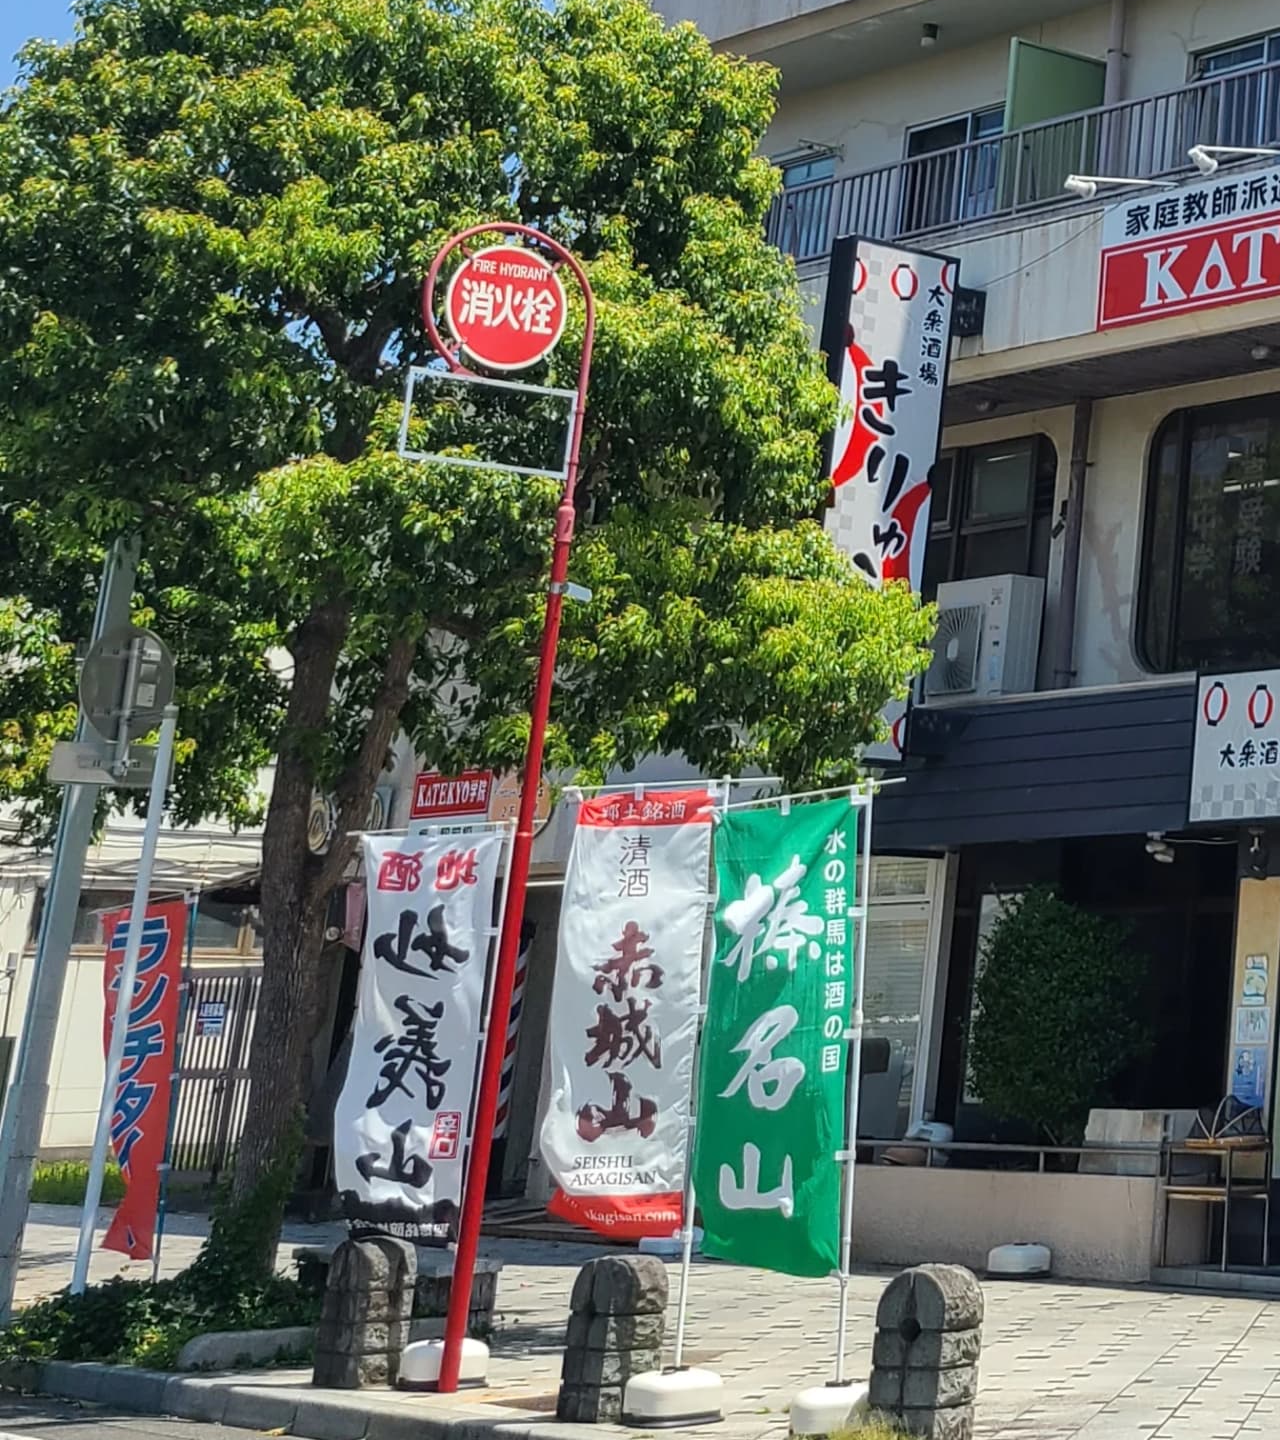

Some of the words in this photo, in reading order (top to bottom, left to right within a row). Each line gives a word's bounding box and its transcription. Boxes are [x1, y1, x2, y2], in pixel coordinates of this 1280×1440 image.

[472, 260, 496, 275] FIRE
[499, 261, 551, 282] HYDRANT
[458, 277, 557, 335] 消火栓
[917, 284, 945, 387] 大衆酒場
[603, 800, 687, 821] 郷土銘酒
[618, 834, 652, 898] 清酒
[821, 830, 849, 1074] 水の群馬は酒の国
[576, 920, 665, 1143] 赤城山
[717, 853, 824, 1218] 榛名山
[570, 1171, 657, 1187] AKAGISAN
[572, 1155, 633, 1170] SEISHU
